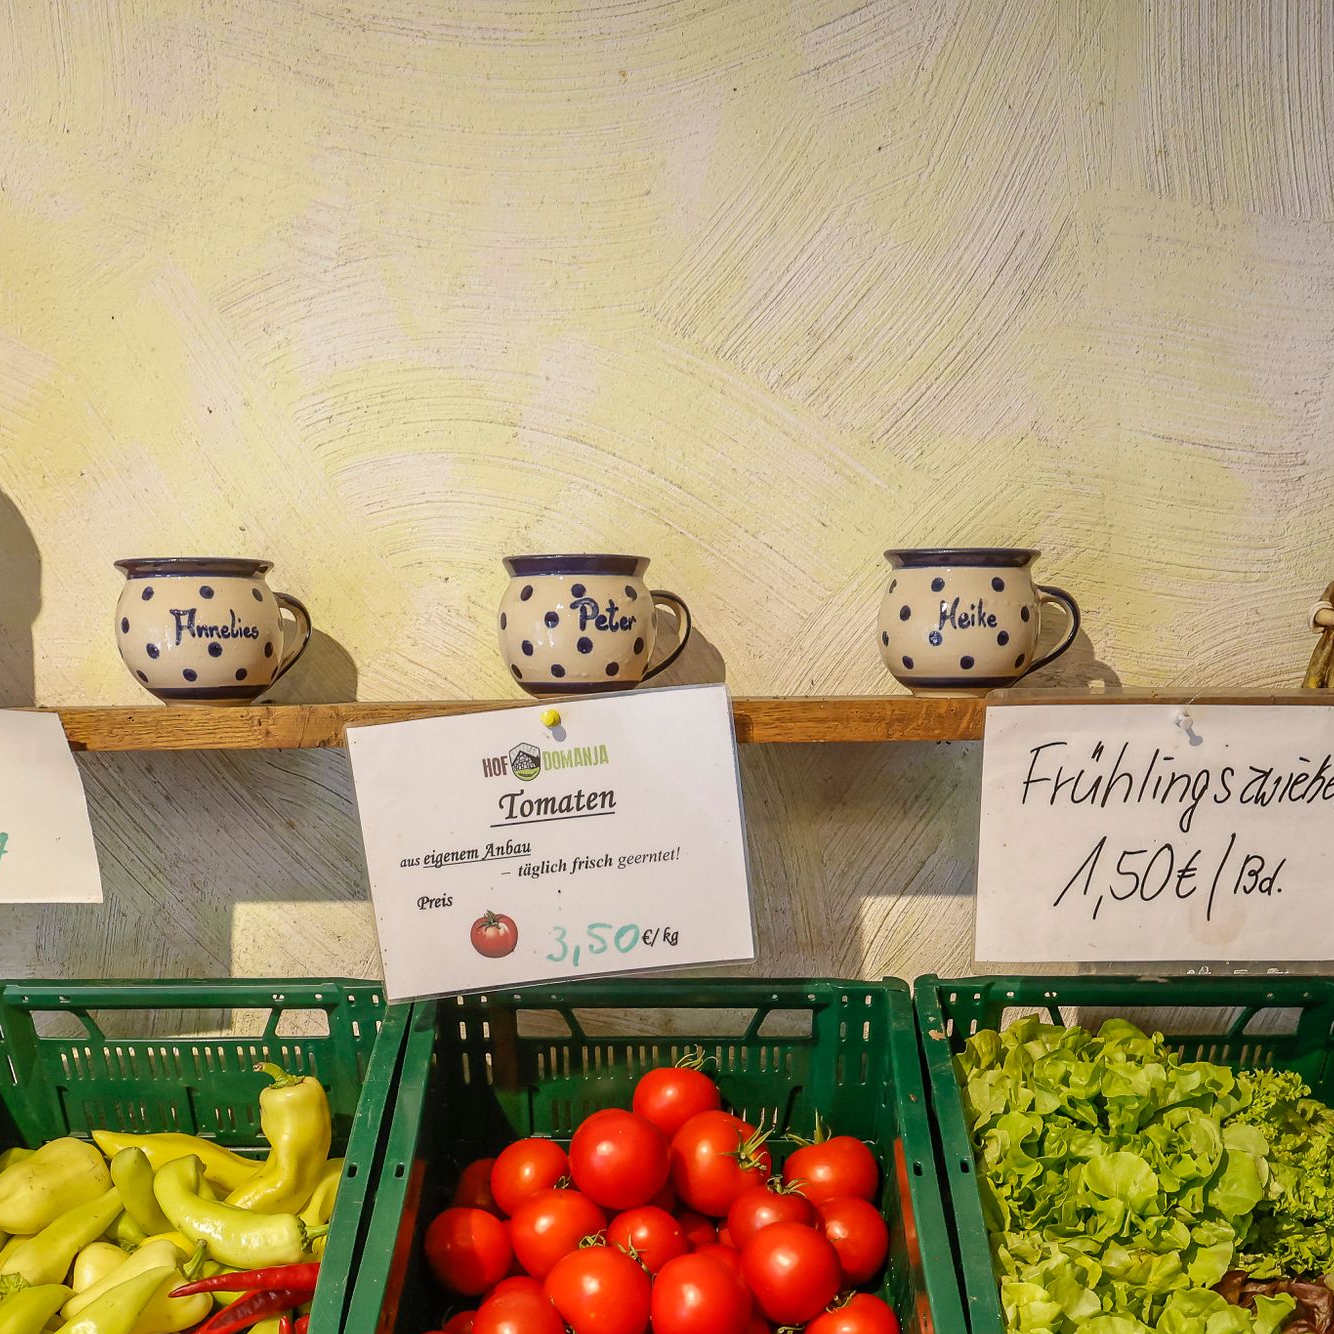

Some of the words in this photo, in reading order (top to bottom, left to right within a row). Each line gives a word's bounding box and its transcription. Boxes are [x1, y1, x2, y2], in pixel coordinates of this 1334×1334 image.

[169, 608, 260, 646] Annelies
[569, 597, 637, 632] Peter
[938, 596, 998, 631] Heike
[482, 755, 509, 779] HOF
[542, 744, 609, 772] DOMANJA
[498, 788, 616, 821] Tomaten
[400, 854, 420, 868] aus
[423, 848, 479, 869] eigenem
[481, 839, 531, 861] Anbau
[518, 859, 567, 879] täglich
[570, 853, 613, 875] frisch
[617, 847, 681, 870] geerntet!
[416, 894, 453, 911] Preis
[546, 922, 641, 967] 3,50
